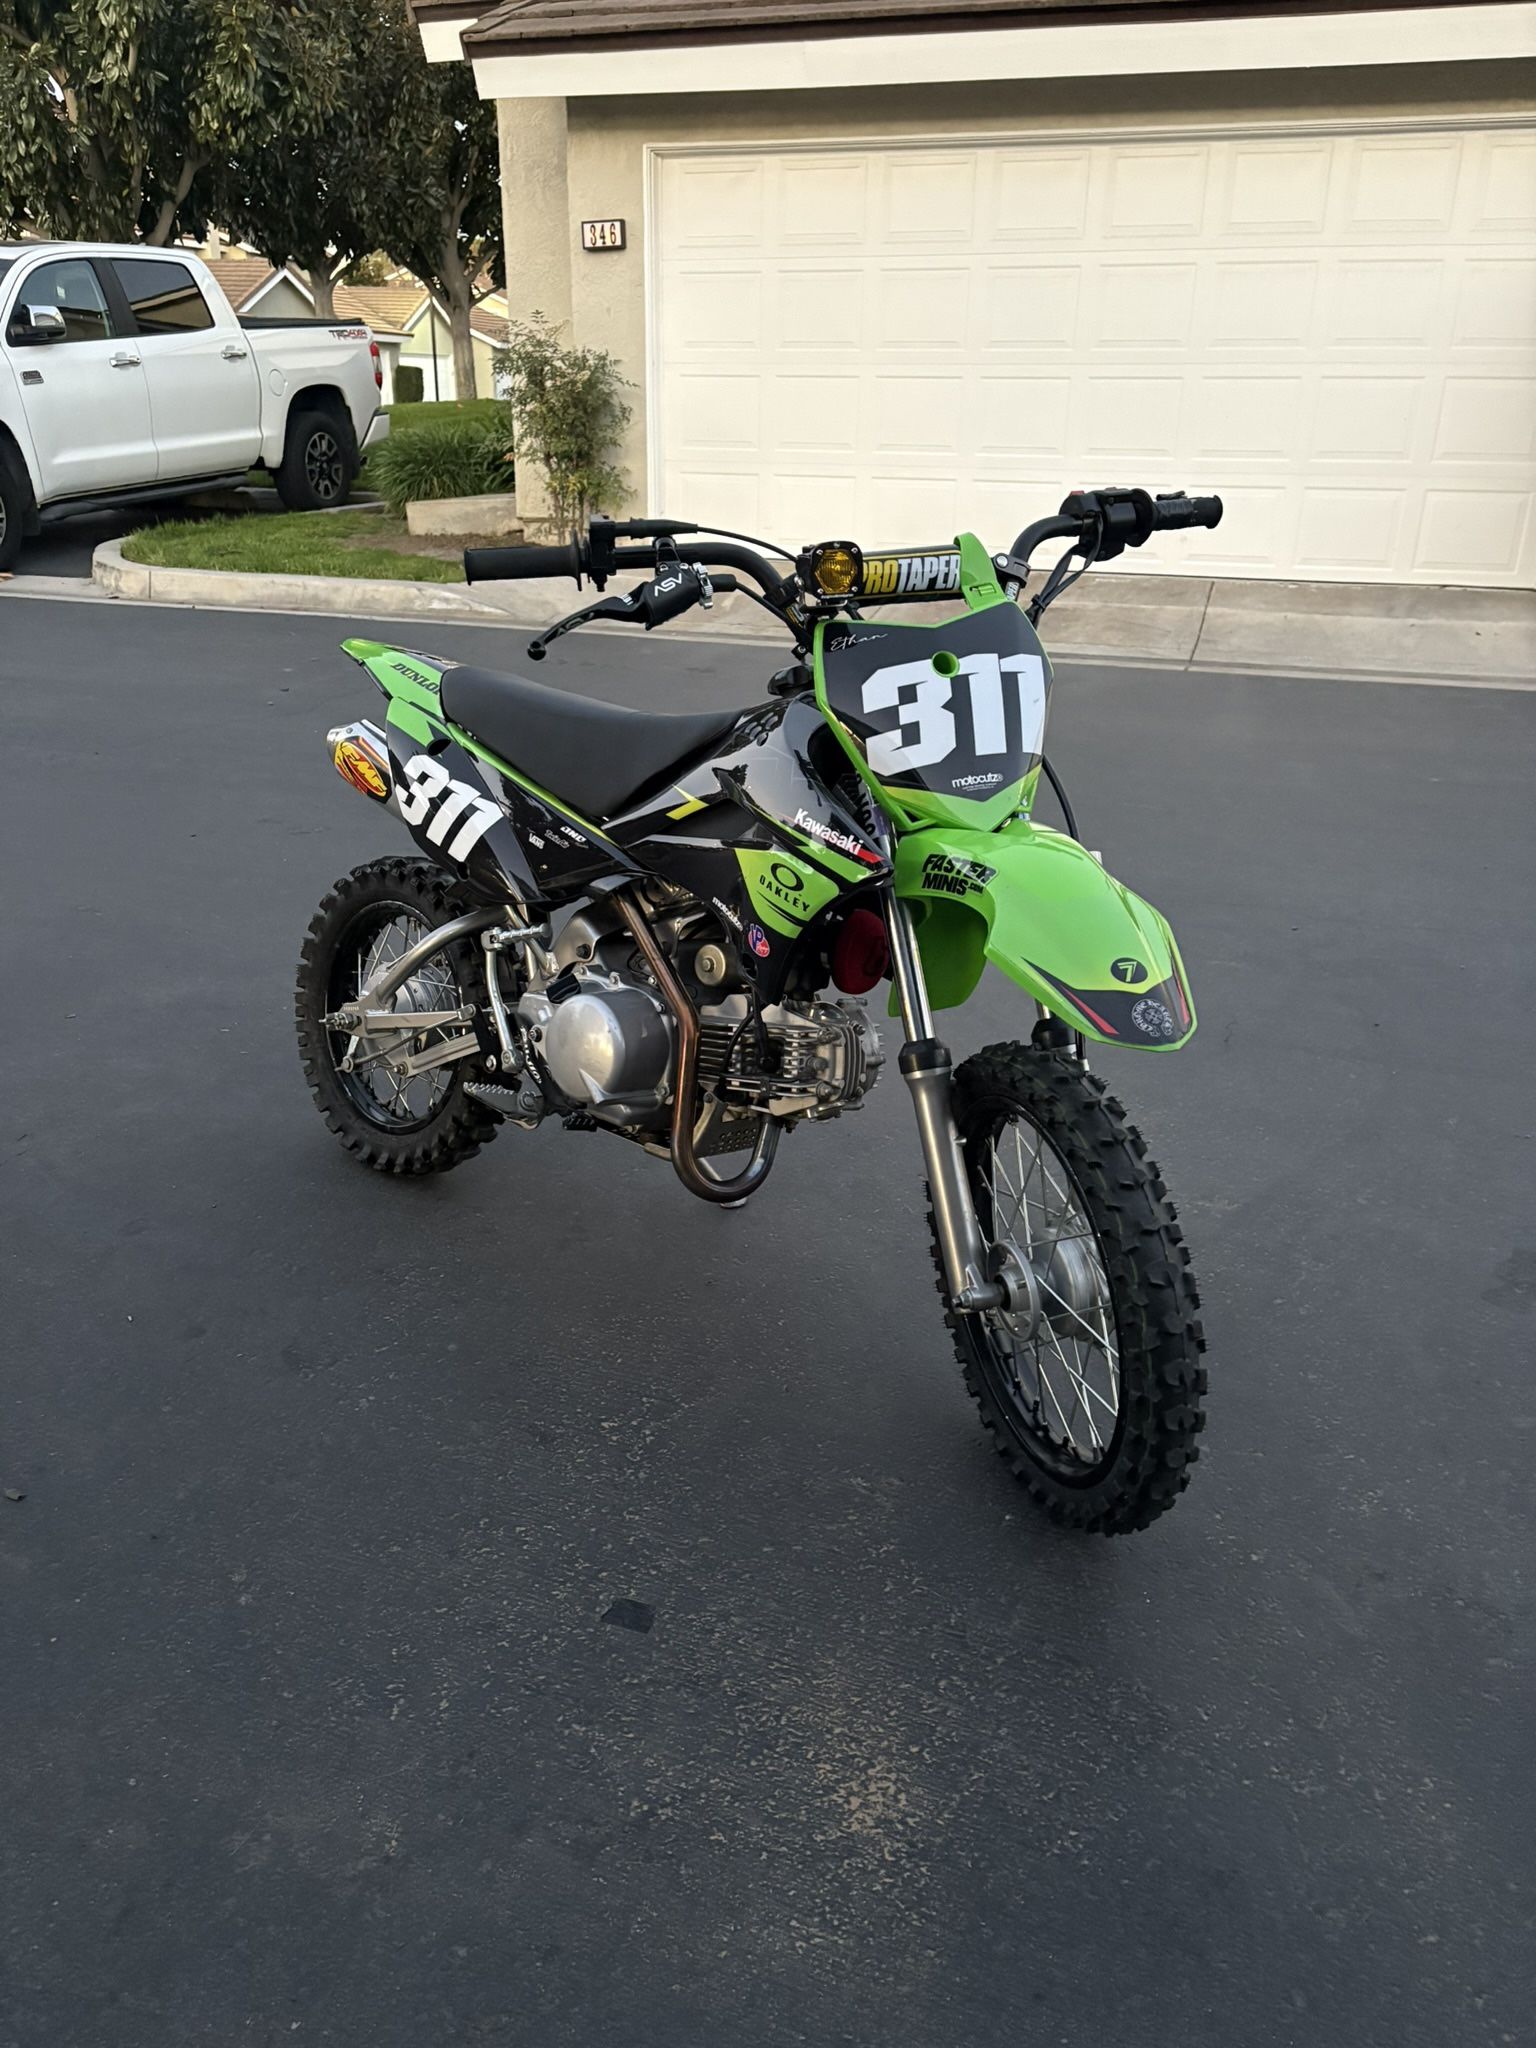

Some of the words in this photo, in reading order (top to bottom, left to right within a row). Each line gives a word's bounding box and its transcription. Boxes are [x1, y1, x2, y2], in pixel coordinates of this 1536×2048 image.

[590, 223, 617, 247] 346
[654, 573, 682, 597] ASV
[830, 633, 888, 651] Ethan
[861, 653, 1046, 777] 311
[395, 754, 504, 863] 311
[794, 807, 864, 856] Kawasaki
[921, 853, 997, 884] FASTER
[759, 874, 810, 913] OAKLEY
